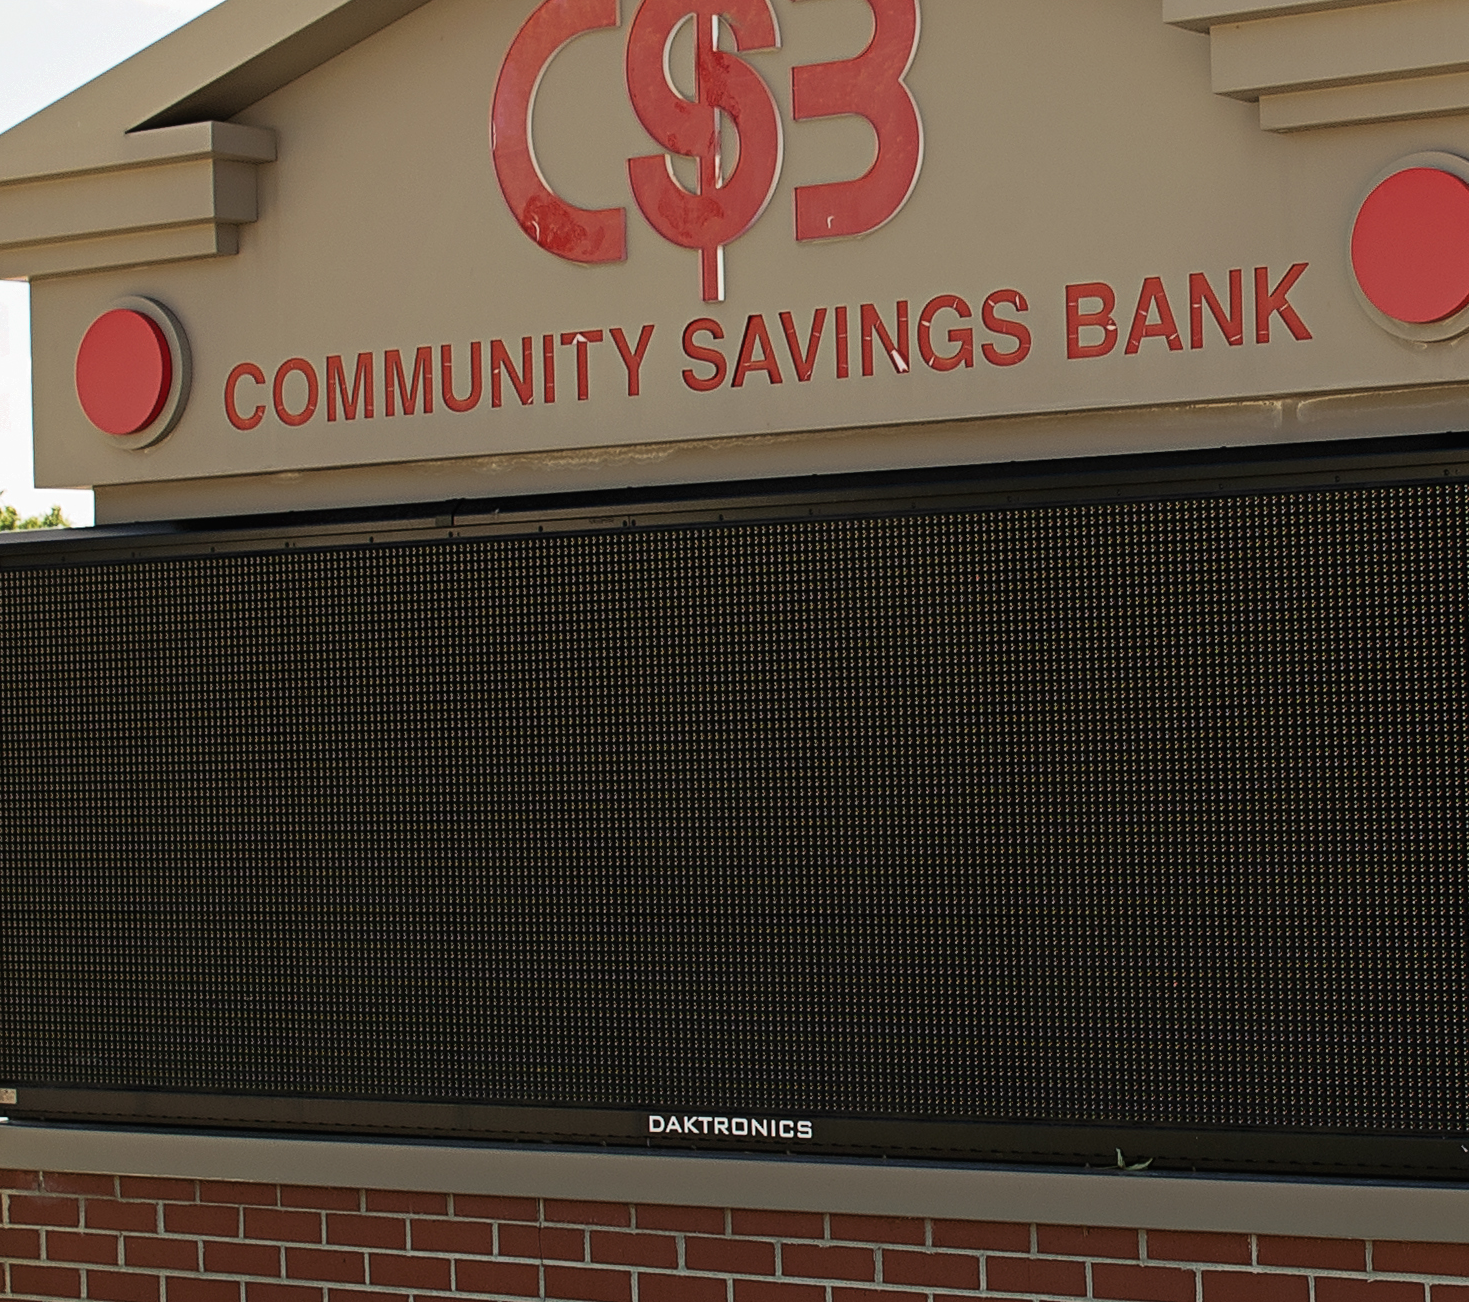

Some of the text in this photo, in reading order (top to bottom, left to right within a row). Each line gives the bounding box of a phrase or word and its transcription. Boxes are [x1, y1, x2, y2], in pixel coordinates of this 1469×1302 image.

[224, 261, 1314, 432] COMMUNITY SAVINGS BANK
[648, 1114, 813, 1139] DAKTRONICS
